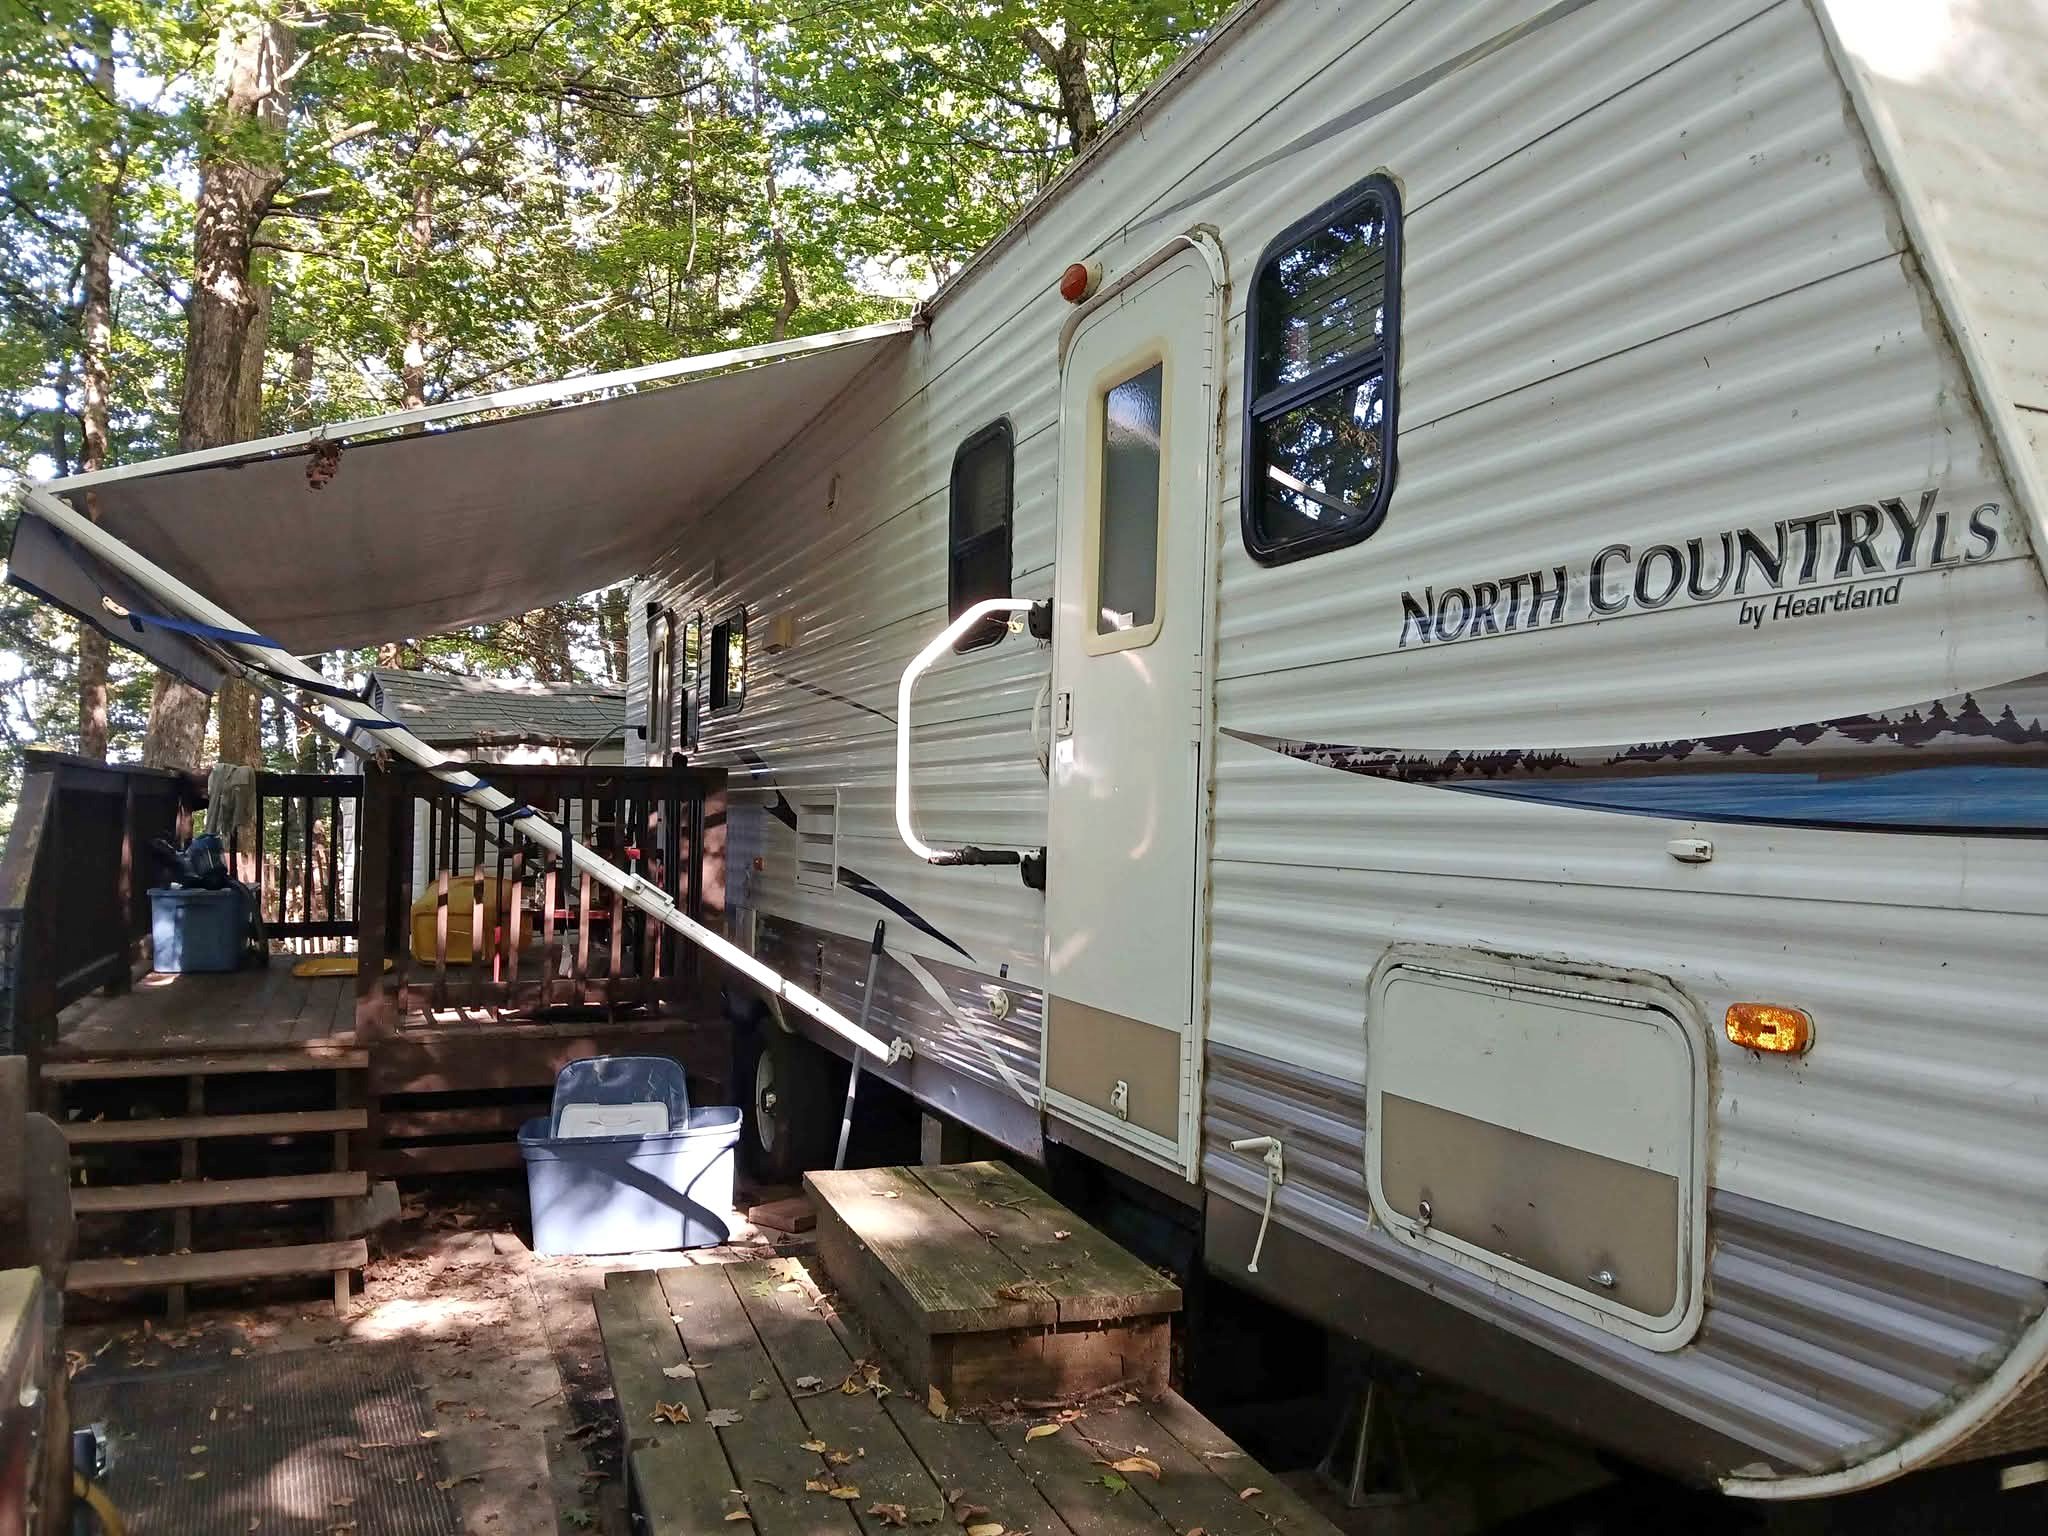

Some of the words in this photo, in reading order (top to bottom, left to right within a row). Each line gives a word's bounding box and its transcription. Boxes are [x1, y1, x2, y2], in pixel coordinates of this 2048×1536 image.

[1398, 565, 1567, 648] NORTH
[1589, 487, 1939, 615] COUNTRY
[1930, 502, 2000, 568] LS
[1738, 600, 1765, 630] by
[1772, 577, 1904, 620] Heartland
